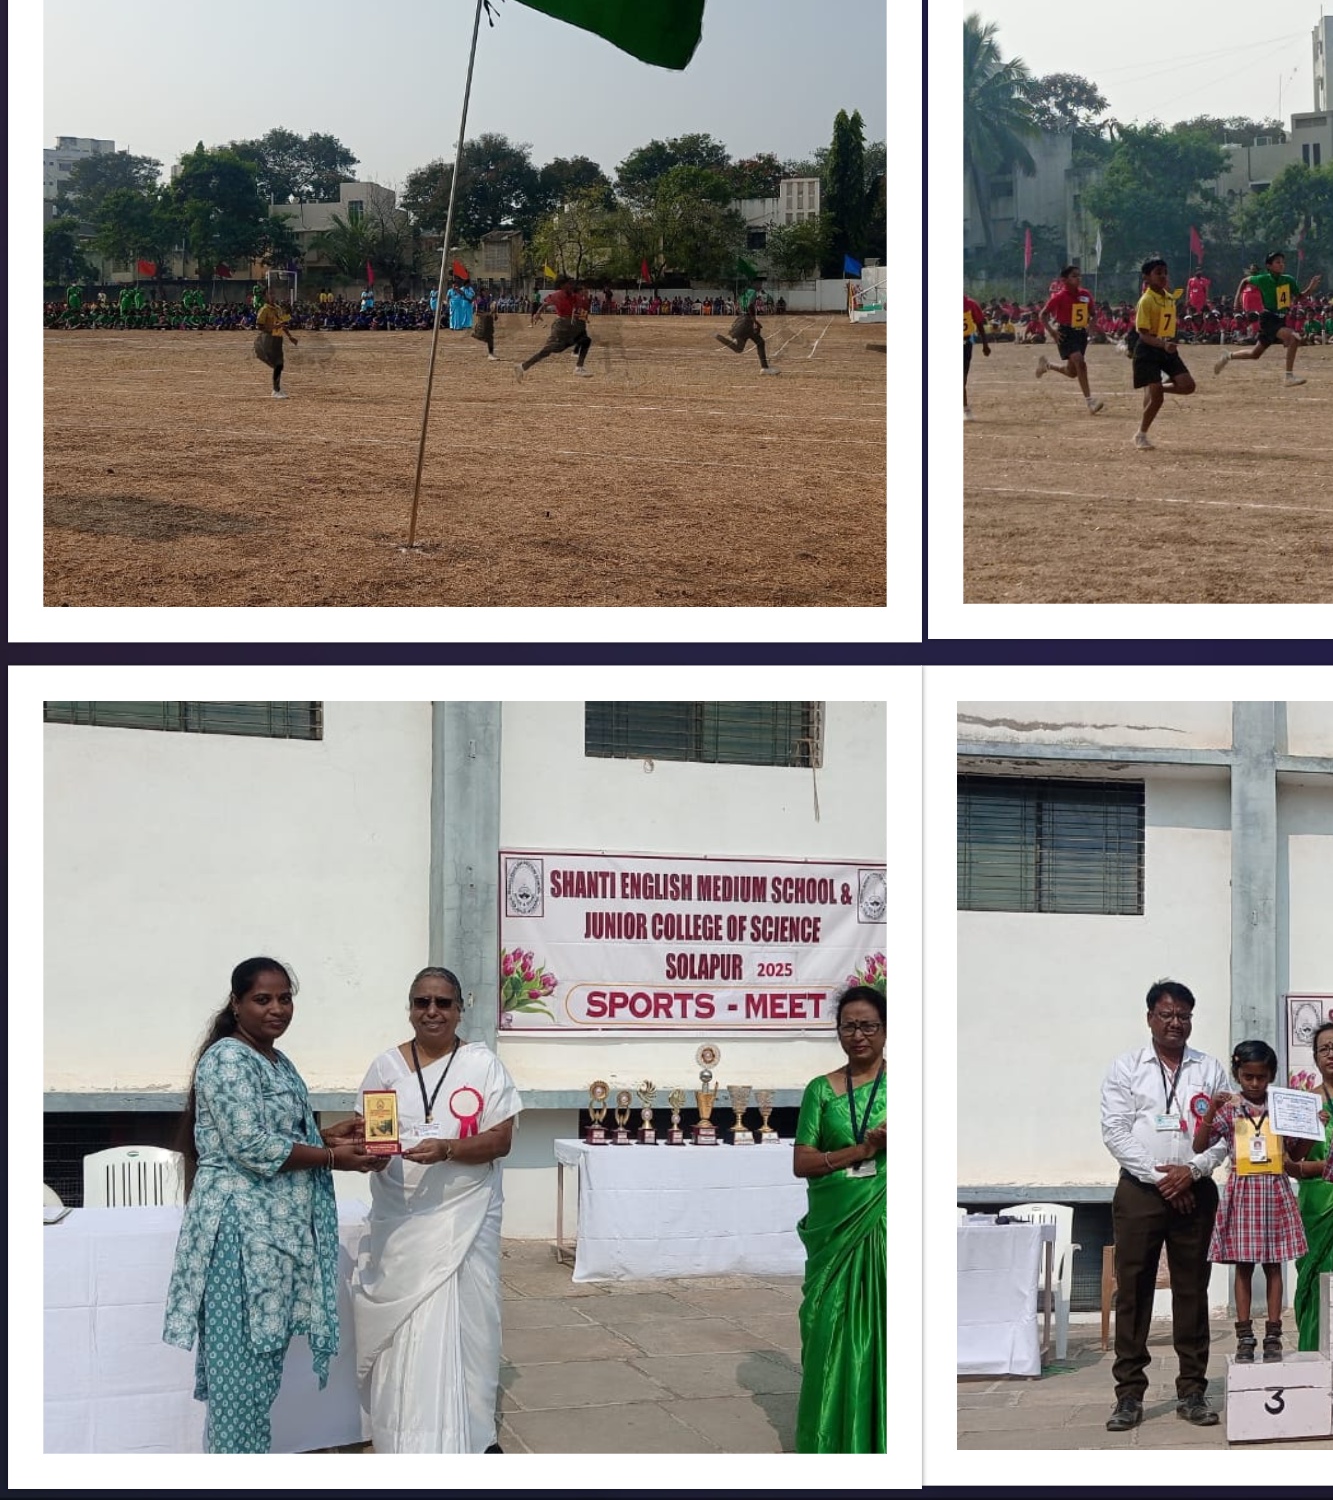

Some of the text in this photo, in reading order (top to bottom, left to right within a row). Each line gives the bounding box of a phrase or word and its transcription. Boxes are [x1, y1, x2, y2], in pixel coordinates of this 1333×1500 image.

[1280, 291, 1287, 304] 4
[1076, 308, 1084, 322] 5
[1163, 314, 1171, 331] 7
[550, 869, 616, 899] SHANTI
[621, 871, 693, 901] ENGLISH
[697, 874, 767, 903] MEDIUM
[771, 877, 837, 905] SCHOOL
[840, 882, 852, 905] &
[584, 911, 821, 944] JUNIOR COLLEGE OF SCIENCE
[665, 952, 793, 981] SOLAPUR 2025
[586, 991, 716, 1020] SPORTS
[745, 993, 827, 1019] MEET
[1264, 1386, 1285, 1415] 3
